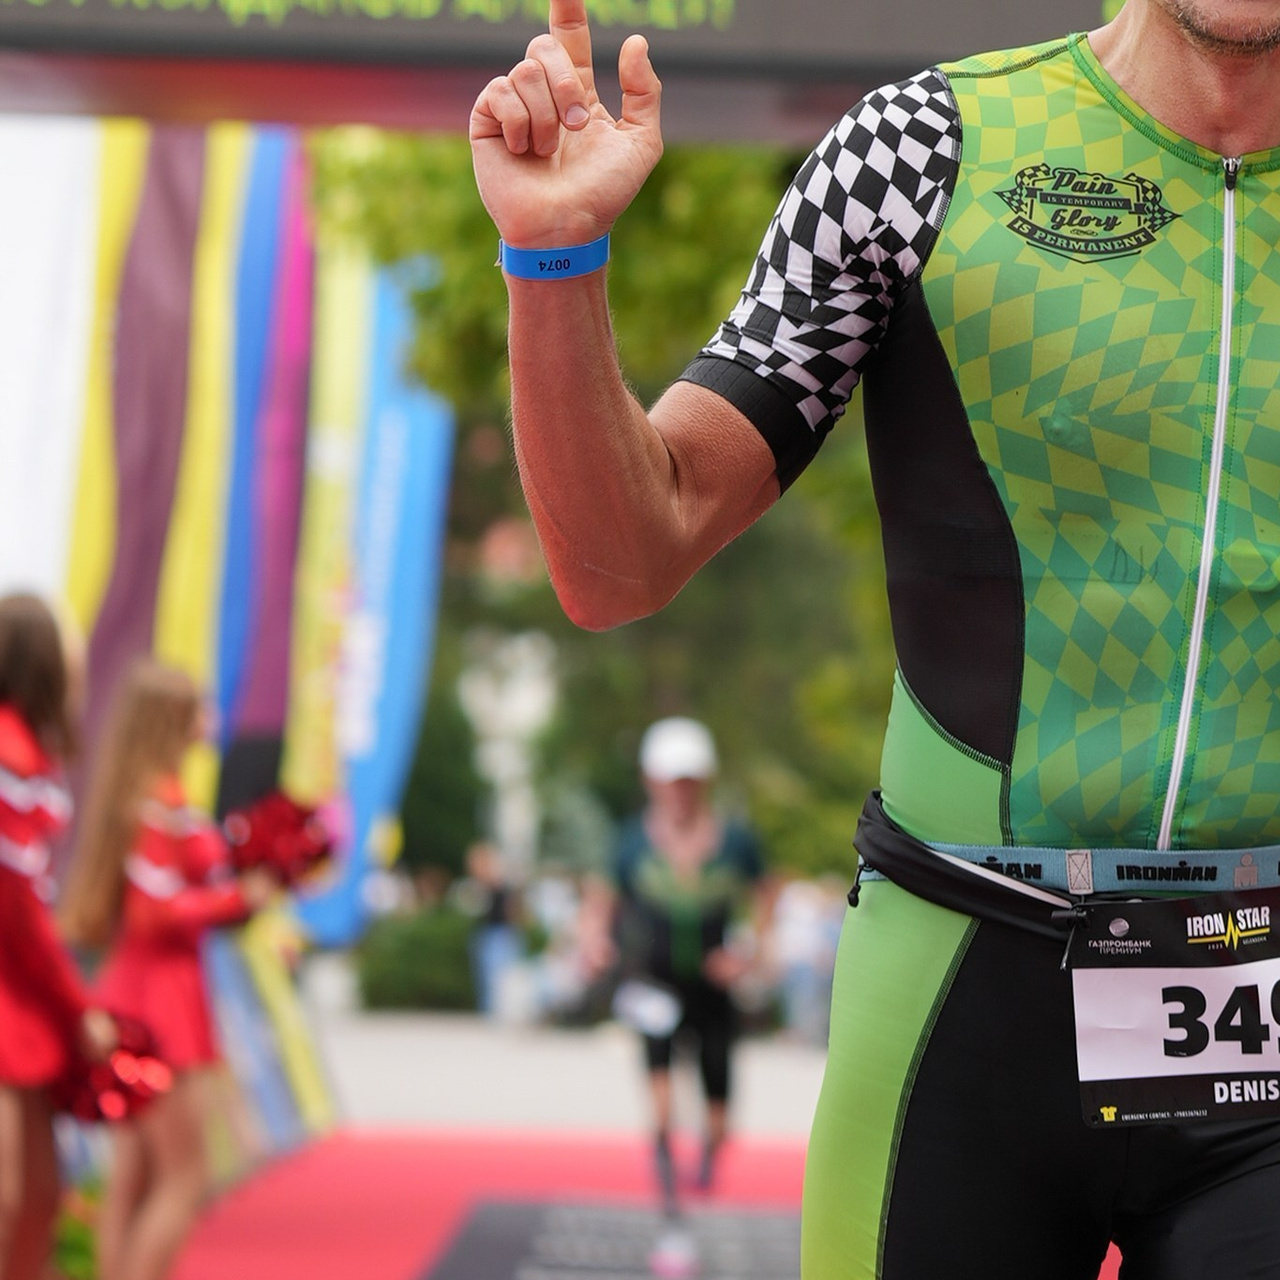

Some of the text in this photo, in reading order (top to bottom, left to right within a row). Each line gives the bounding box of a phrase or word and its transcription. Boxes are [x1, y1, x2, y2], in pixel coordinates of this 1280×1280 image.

[1052, 171, 1117, 195] Pain
[1061, 197, 1125, 208] TEMPORARY
[1051, 208, 1121, 231] Glory
[1013, 220, 1149, 252] IS PERMANENT
[538, 258, 571, 272] 0074
[1116, 861, 1218, 882] IRONMAN
[1186, 906, 1270, 937] IRON STAR
[1088, 939, 1152, 949] ГАЗПРОМБАНК
[1099, 946, 1142, 955] ПРЕМИУМ
[1213, 1079, 1280, 1104] DENIS
